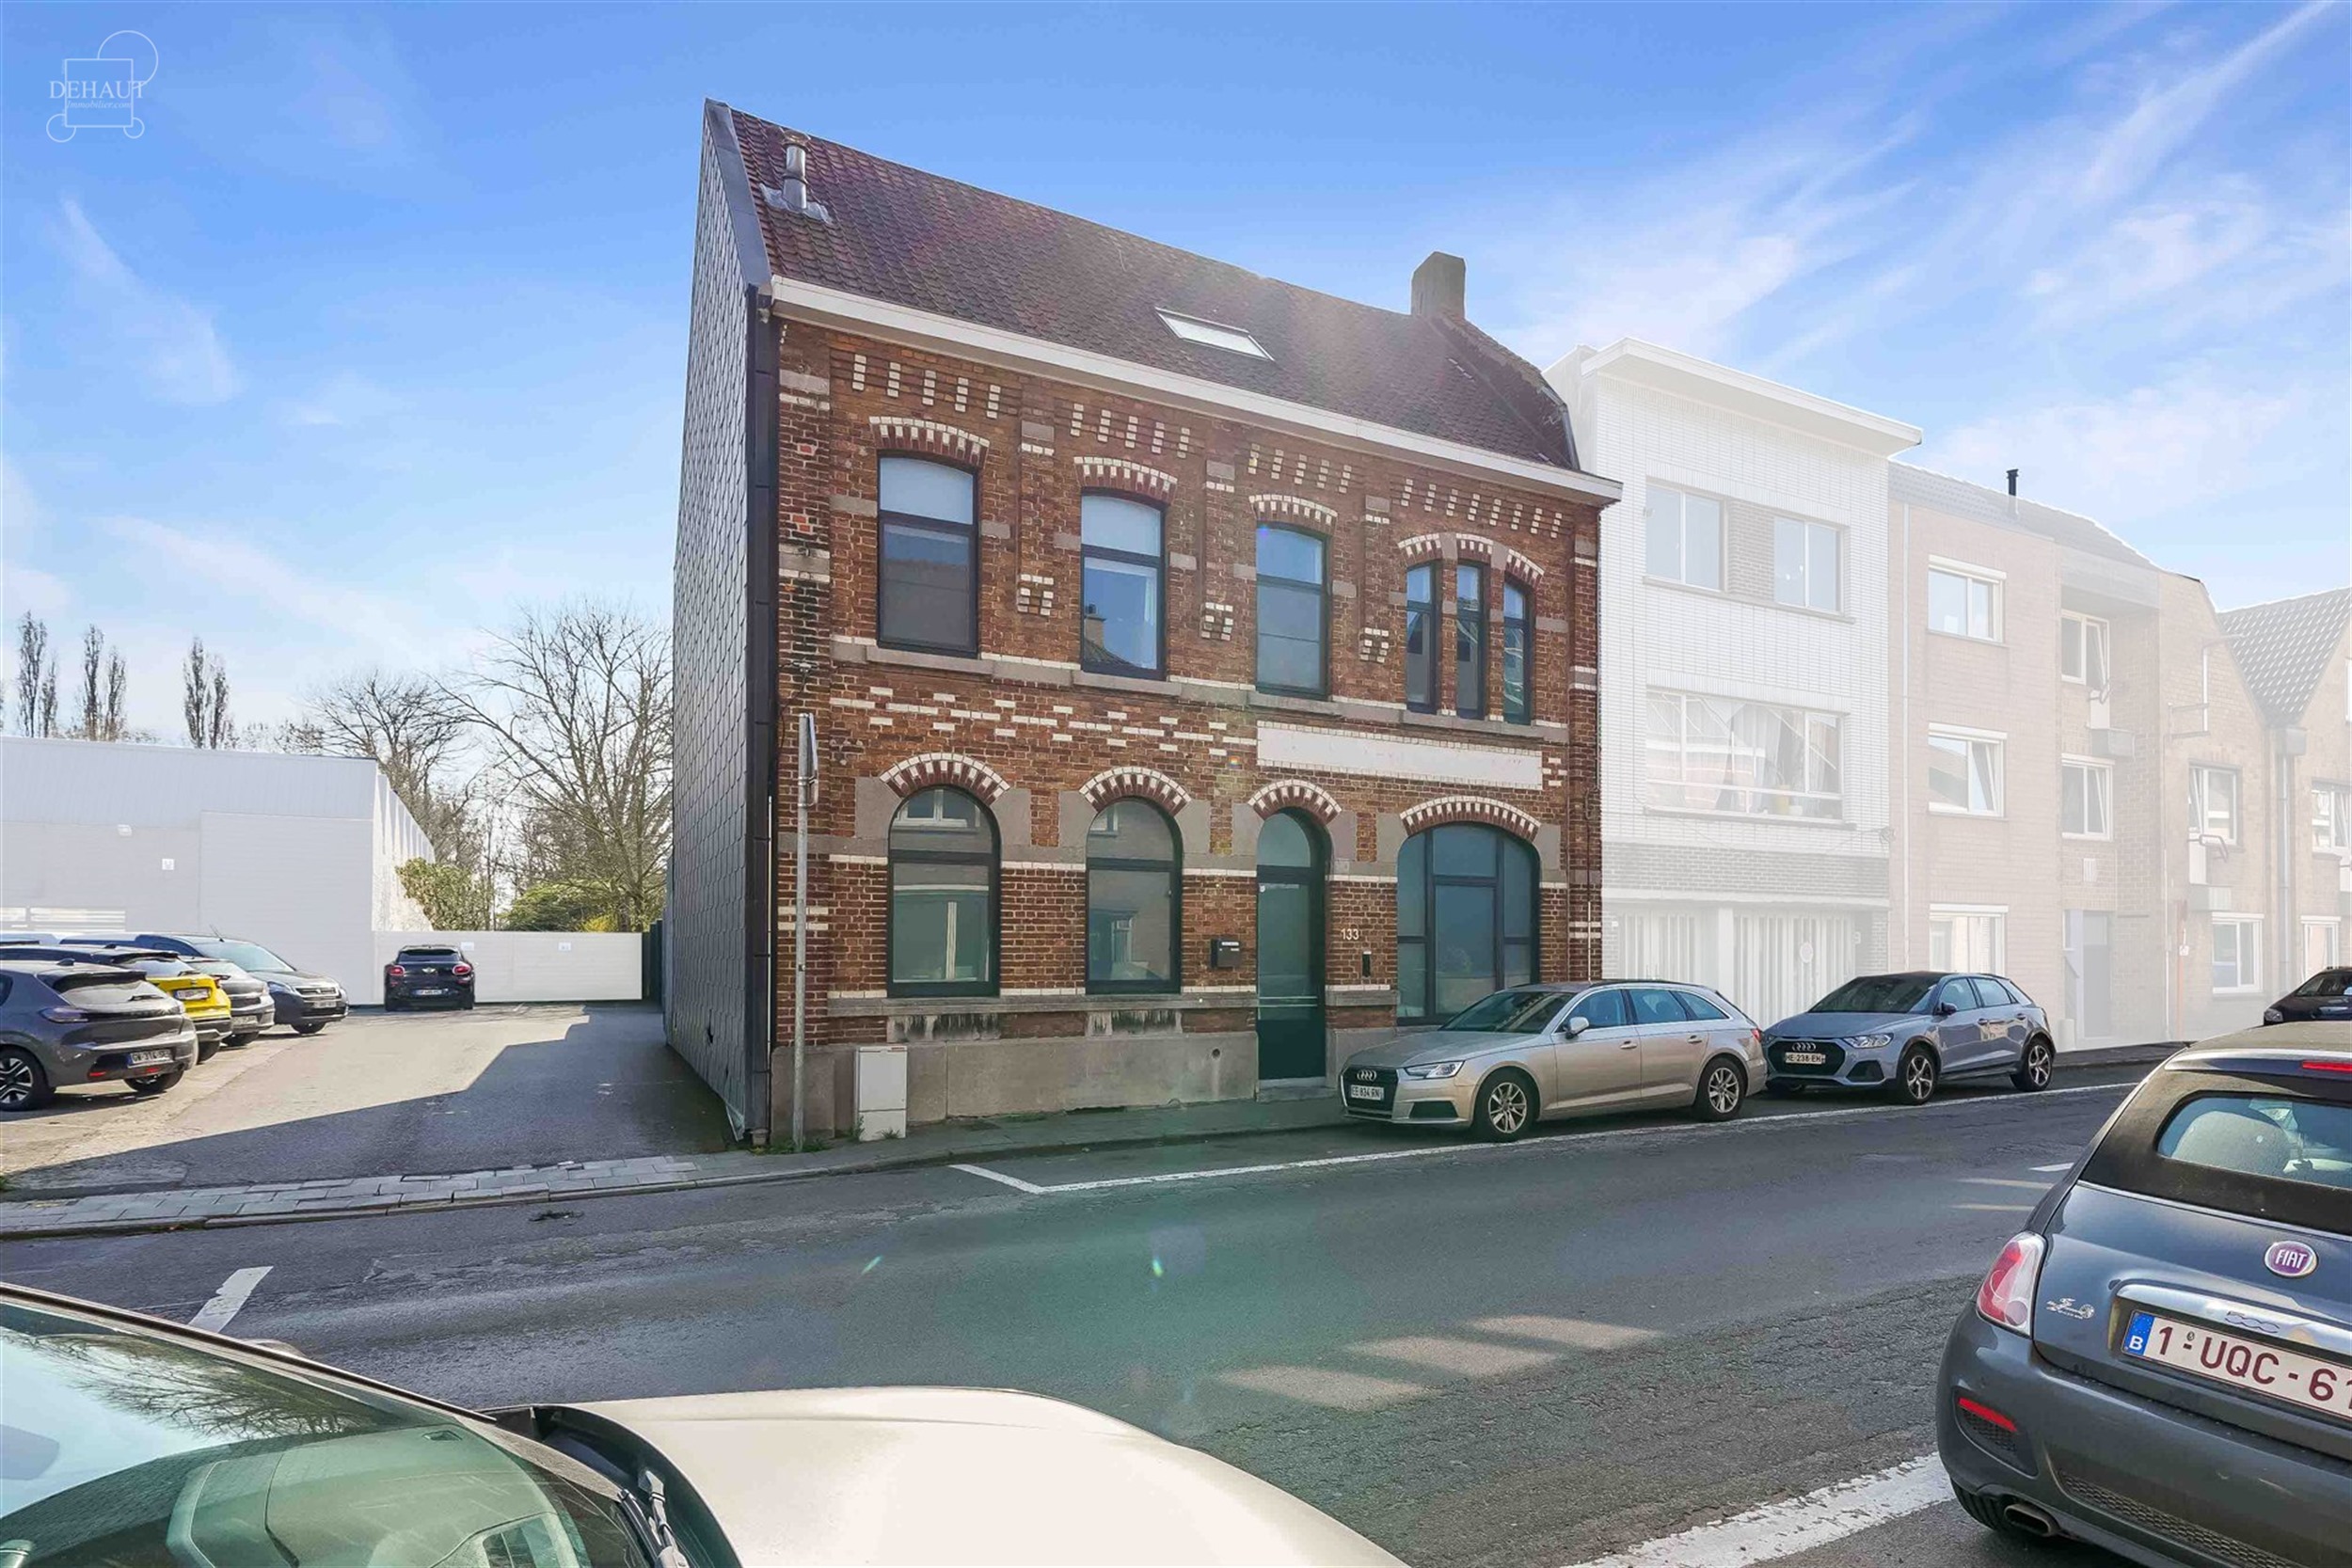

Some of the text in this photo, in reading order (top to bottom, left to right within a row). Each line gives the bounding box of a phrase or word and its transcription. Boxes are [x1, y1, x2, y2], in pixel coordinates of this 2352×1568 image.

[1341, 928, 1359, 941] 133
[2274, 1248, 2308, 1270] FIAT
[2128, 1336, 2144, 1352] B
